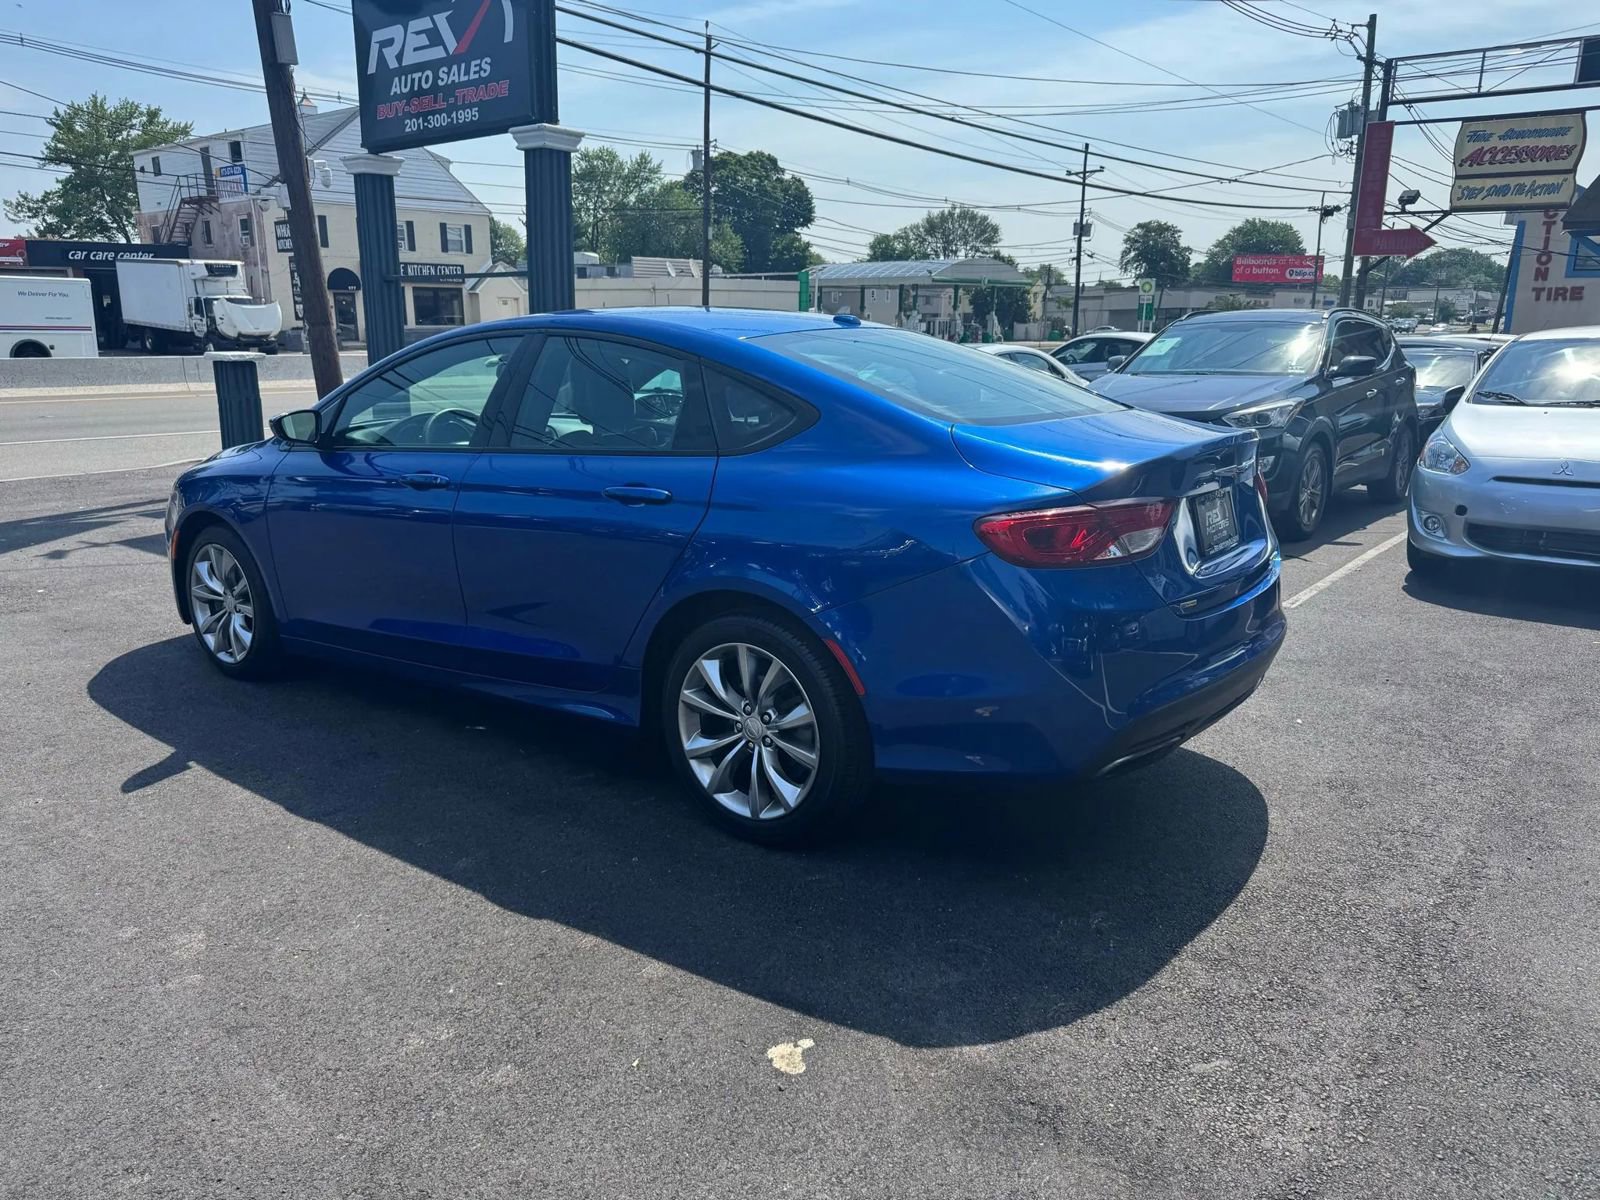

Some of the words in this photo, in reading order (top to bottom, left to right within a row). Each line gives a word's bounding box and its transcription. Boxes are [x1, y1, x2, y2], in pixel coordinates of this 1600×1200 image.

[390, 69, 433, 96] AUTO
[437, 56, 491, 86] SALES
[404, 107, 479, 132] 201-300-1995
[1459, 144, 1577, 167] ACCESSORIES
[68, 250, 88, 260] car
[90, 251, 115, 261] care
[1236, 256, 1277, 265] Billboards
[408, 264, 436, 277] KITCHEN
[437, 265, 462, 276] CENTER
[1532, 286, 1584, 302] TIRE
